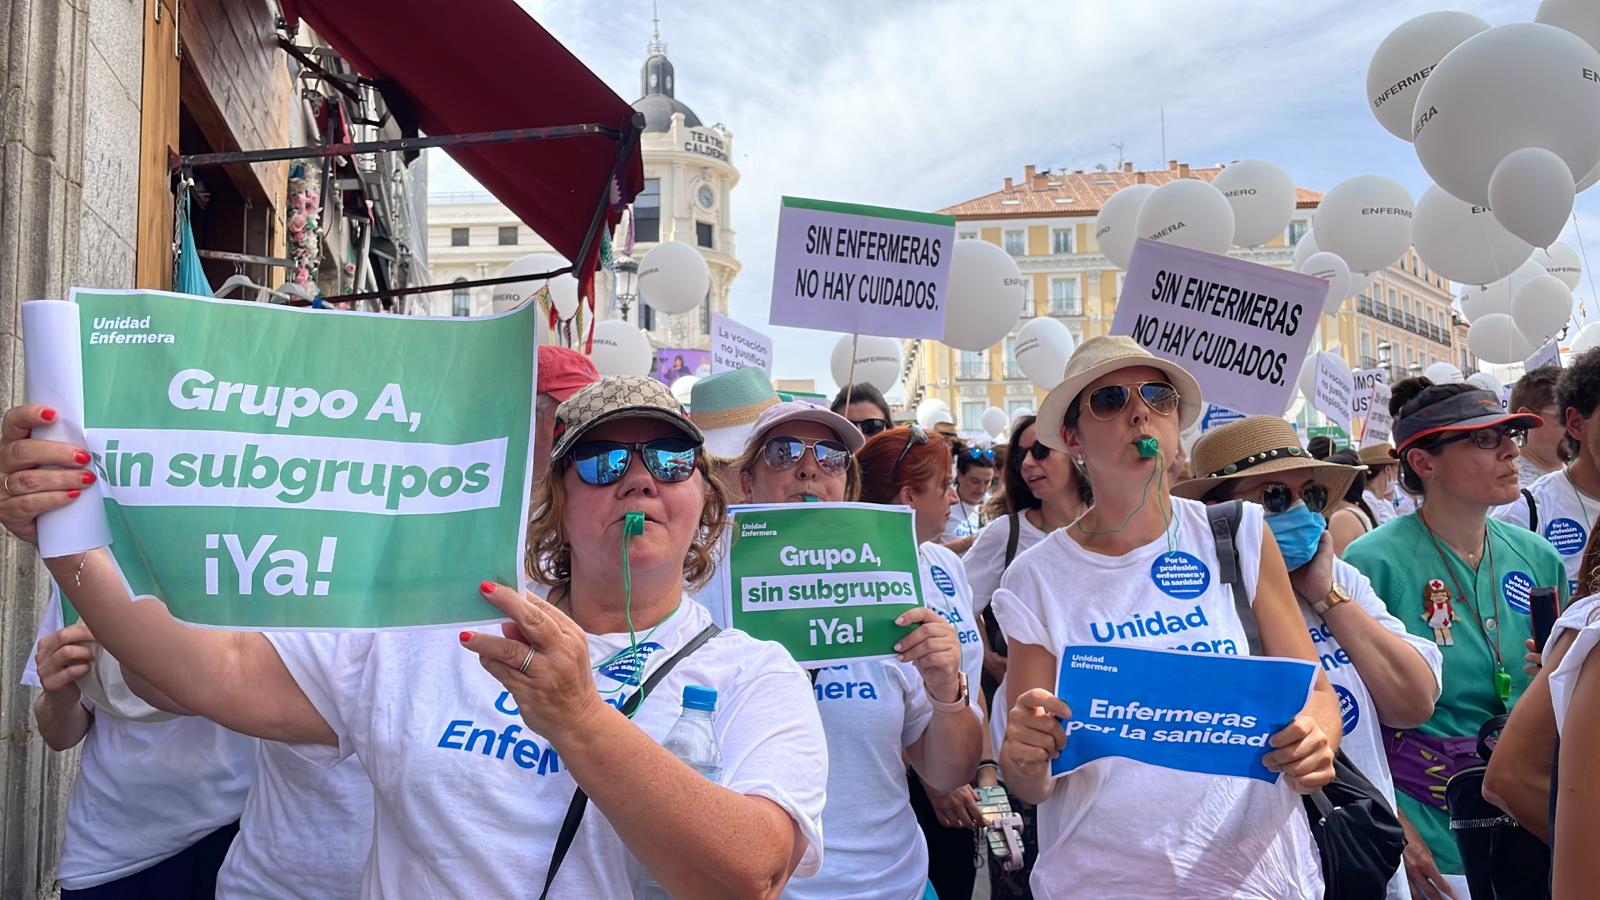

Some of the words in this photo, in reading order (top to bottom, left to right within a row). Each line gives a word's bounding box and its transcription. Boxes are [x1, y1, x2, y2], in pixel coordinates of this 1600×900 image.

[806, 225, 832, 256] SIN
[836, 229, 941, 268] ENFERMERAS
[795, 268, 818, 298] NO
[822, 271, 856, 302] HAY
[858, 276, 938, 311] CUIDADOS.
[1152, 270, 1183, 305] SIN
[1181, 277, 1302, 337] ENFERMERAS
[92, 315, 150, 330] Unidad
[89, 331, 175, 345] Enfermera
[718, 326, 729, 339] La
[731, 333, 768, 355] vocación
[721, 344, 733, 354] no
[1132, 313, 1158, 347] NO
[1157, 322, 1196, 357] HAY
[1193, 331, 1287, 386] CUIDADOS.
[168, 368, 358, 428] Grupo
[365, 383, 422, 433] A,
[166, 444, 490, 510] subgrupos
[741, 529, 777, 537] Enfermera
[742, 522, 767, 530] Unidad
[205, 533, 337, 596] ¡Ya!
[780, 545, 856, 570] Grupo
[860, 543, 881, 567] A,
[1160, 564, 1198, 573] profesión
[748, 582, 783, 603] sin
[789, 578, 912, 604] subgrupos
[1171, 578, 1203, 586] sanidad
[809, 616, 863, 646] ¡Ya!
[1090, 605, 1208, 643] Unidad
[1071, 661, 1118, 673] Enfermera
[1072, 654, 1104, 664] Unidad
[1089, 699, 1257, 729] Enfermeras
[1066, 720, 1115, 736] por
[1120, 724, 1146, 740] la
[1152, 727, 1269, 748] sanidad
